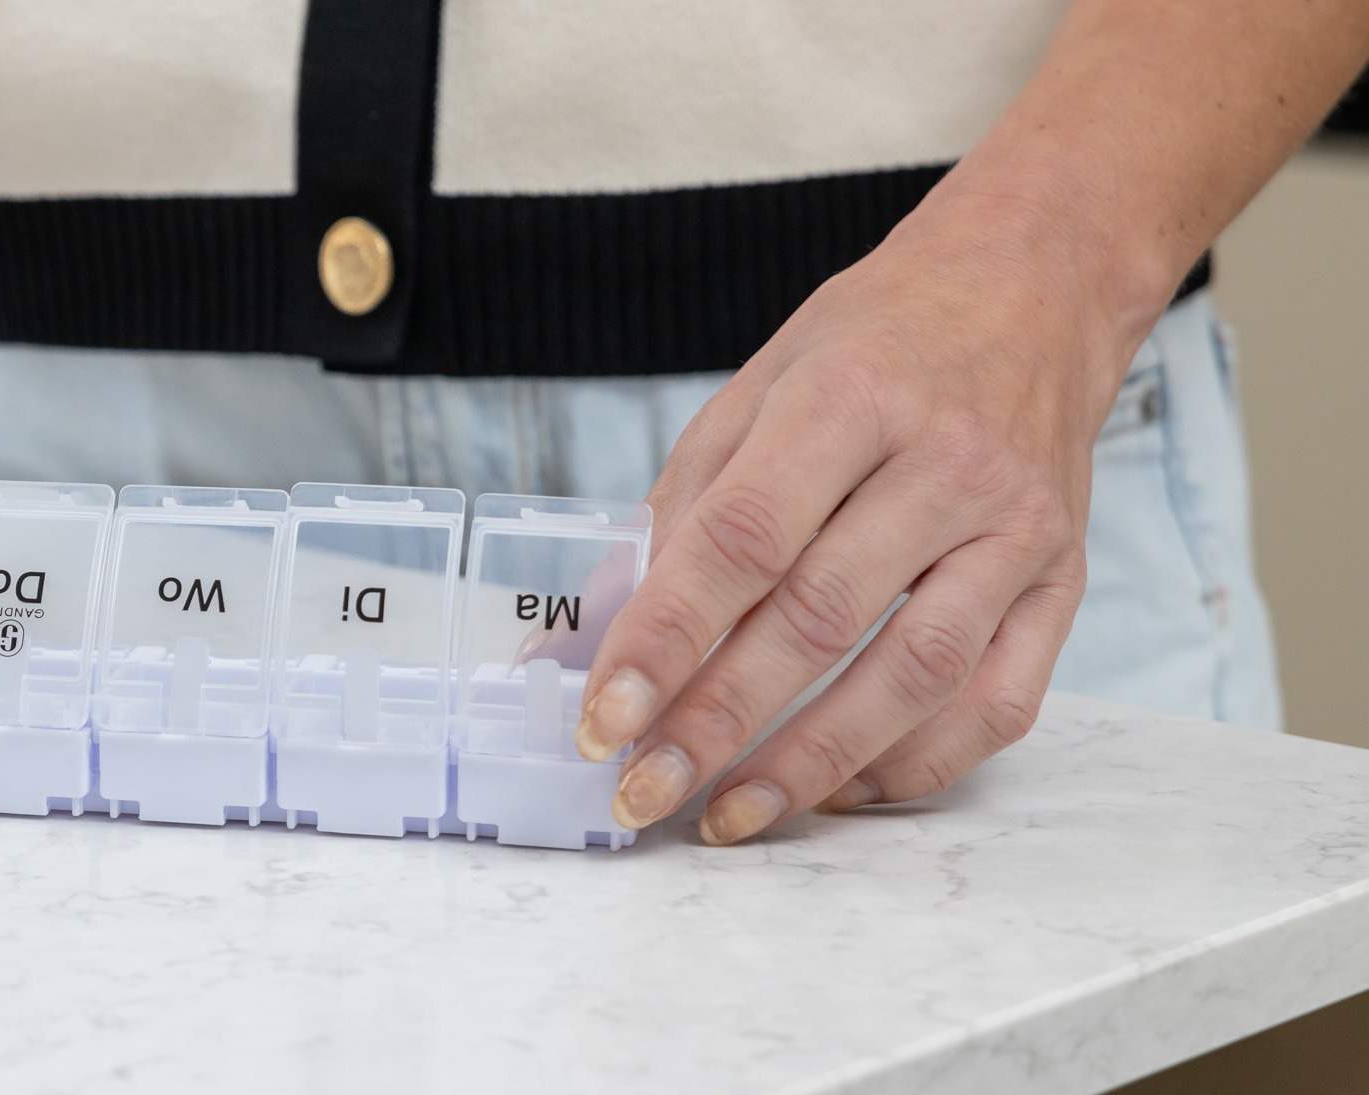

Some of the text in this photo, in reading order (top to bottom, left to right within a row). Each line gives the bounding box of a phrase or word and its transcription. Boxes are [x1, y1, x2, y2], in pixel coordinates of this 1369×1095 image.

[158, 577, 226, 613] Wo
[341, 586, 386, 624] Di
[516, 594, 581, 632] Ma
